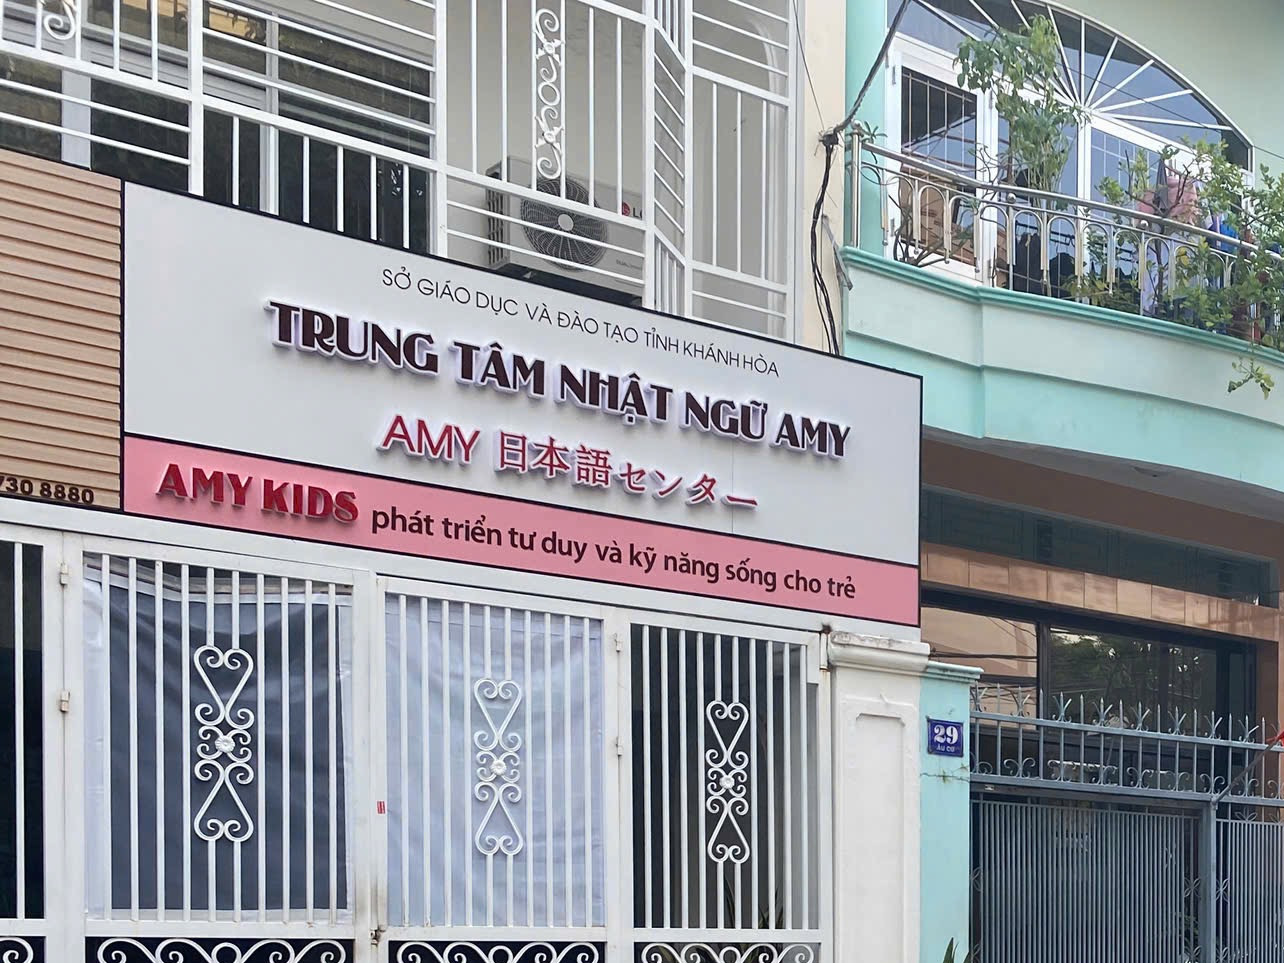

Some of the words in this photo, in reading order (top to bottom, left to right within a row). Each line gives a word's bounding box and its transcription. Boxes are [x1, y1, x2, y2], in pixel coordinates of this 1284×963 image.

[381, 266, 412, 290] SỞ
[417, 278, 471, 304] GIÁO
[475, 291, 519, 316] DỤC
[525, 303, 552, 325] VÀ
[557, 311, 599, 335] ĐÀO
[603, 321, 639, 343] TẠO
[643, 327, 679, 354] TỈNH
[683, 340, 740, 368] KHÁNH
[743, 353, 780, 378] HÒA
[269, 301, 439, 374] TRUNG
[453, 341, 546, 396] TÂM
[559, 364, 673, 424] NHẬT
[685, 391, 768, 440] NGỮ
[775, 413, 851, 457] AMY
[40, 482, 94, 505] 8880
[382, 414, 481, 462] AMY
[499, 430, 758, 507] 日本語センター
[156, 463, 253, 506] AMY
[263, 478, 359, 523] KIDS
[372, 506, 434, 536] phát
[441, 514, 502, 546] triển
[508, 527, 538, 551] tư
[541, 531, 588, 563] duy
[595, 540, 622, 563] và
[629, 543, 657, 573] kỹ
[664, 552, 720, 583] năng
[725, 558, 777, 592] sống
[784, 570, 822, 594] cho
[827, 575, 856, 599] trẻ
[934, 725, 959, 745] 29
